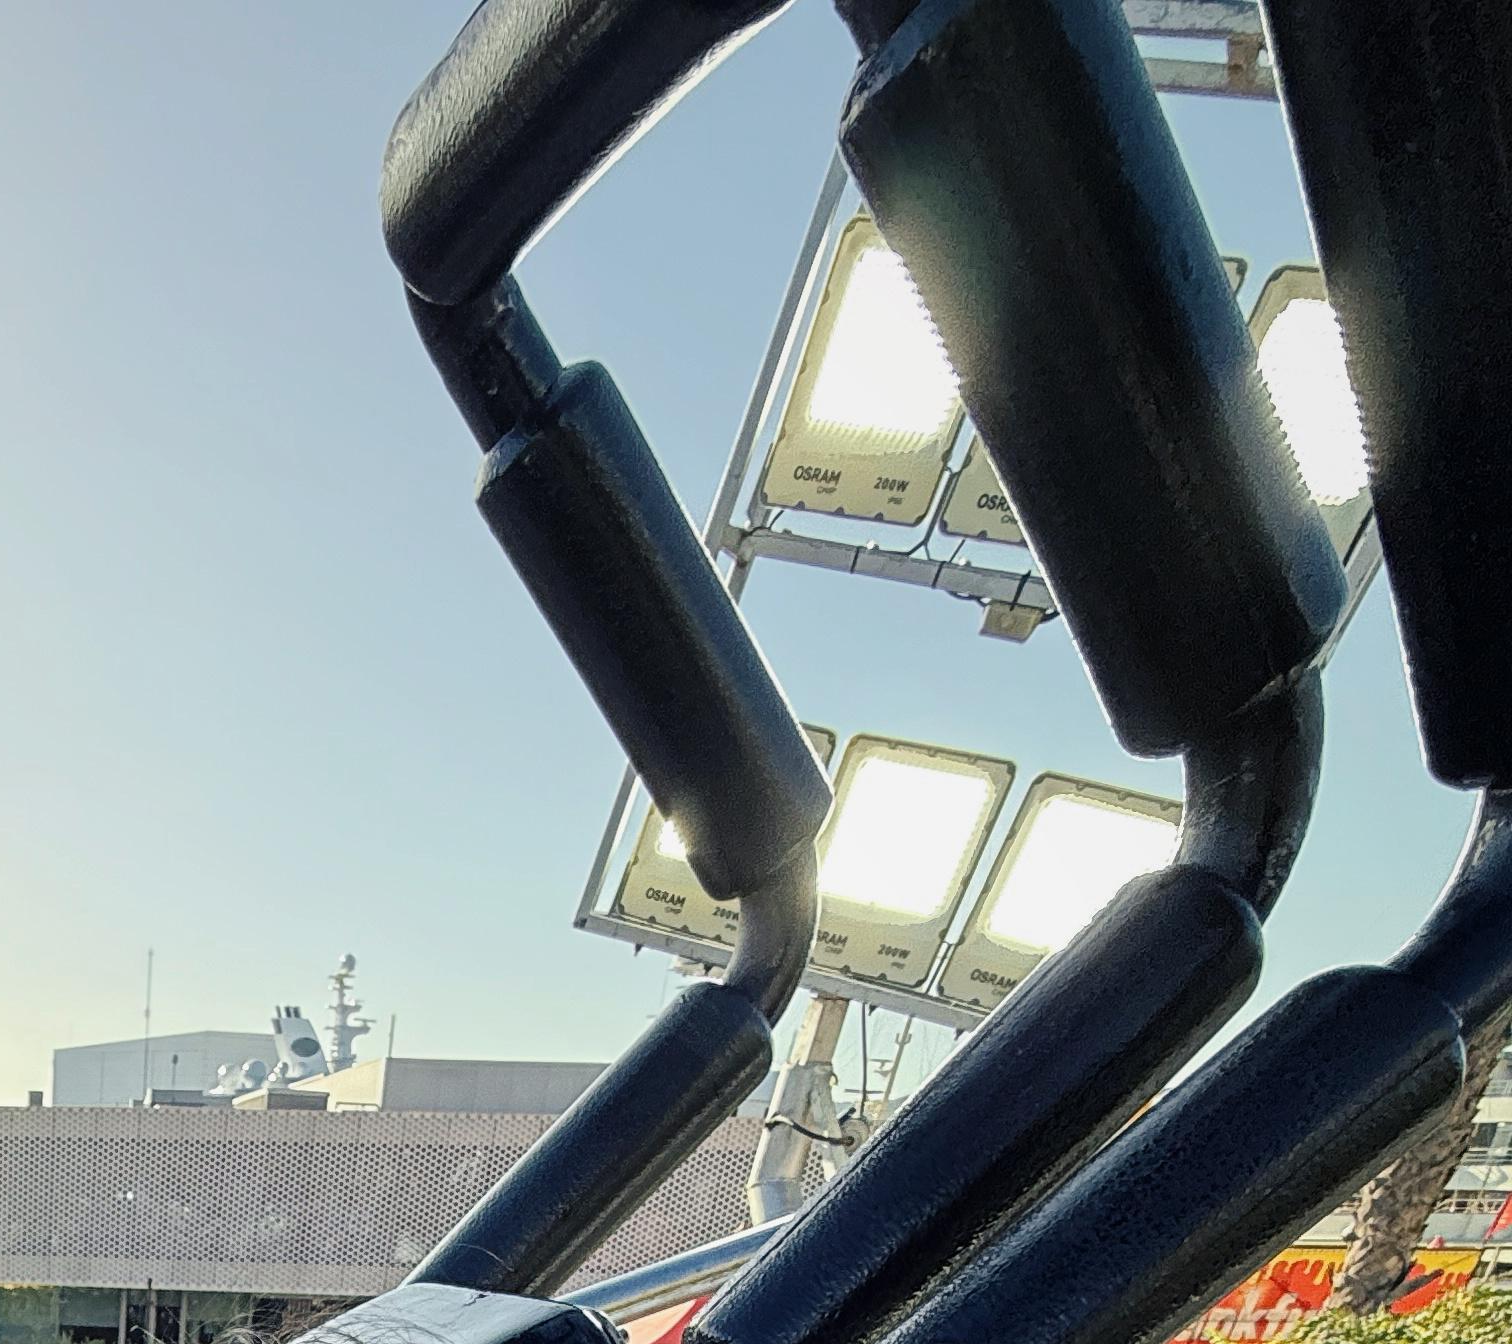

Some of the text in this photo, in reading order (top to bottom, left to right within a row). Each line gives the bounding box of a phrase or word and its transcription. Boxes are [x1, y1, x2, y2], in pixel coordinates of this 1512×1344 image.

[793, 465, 910, 493] OSRAM 200W
[977, 494, 1011, 511] OSR
[645, 887, 687, 907] OSRAM
[816, 929, 849, 948] SRAM
